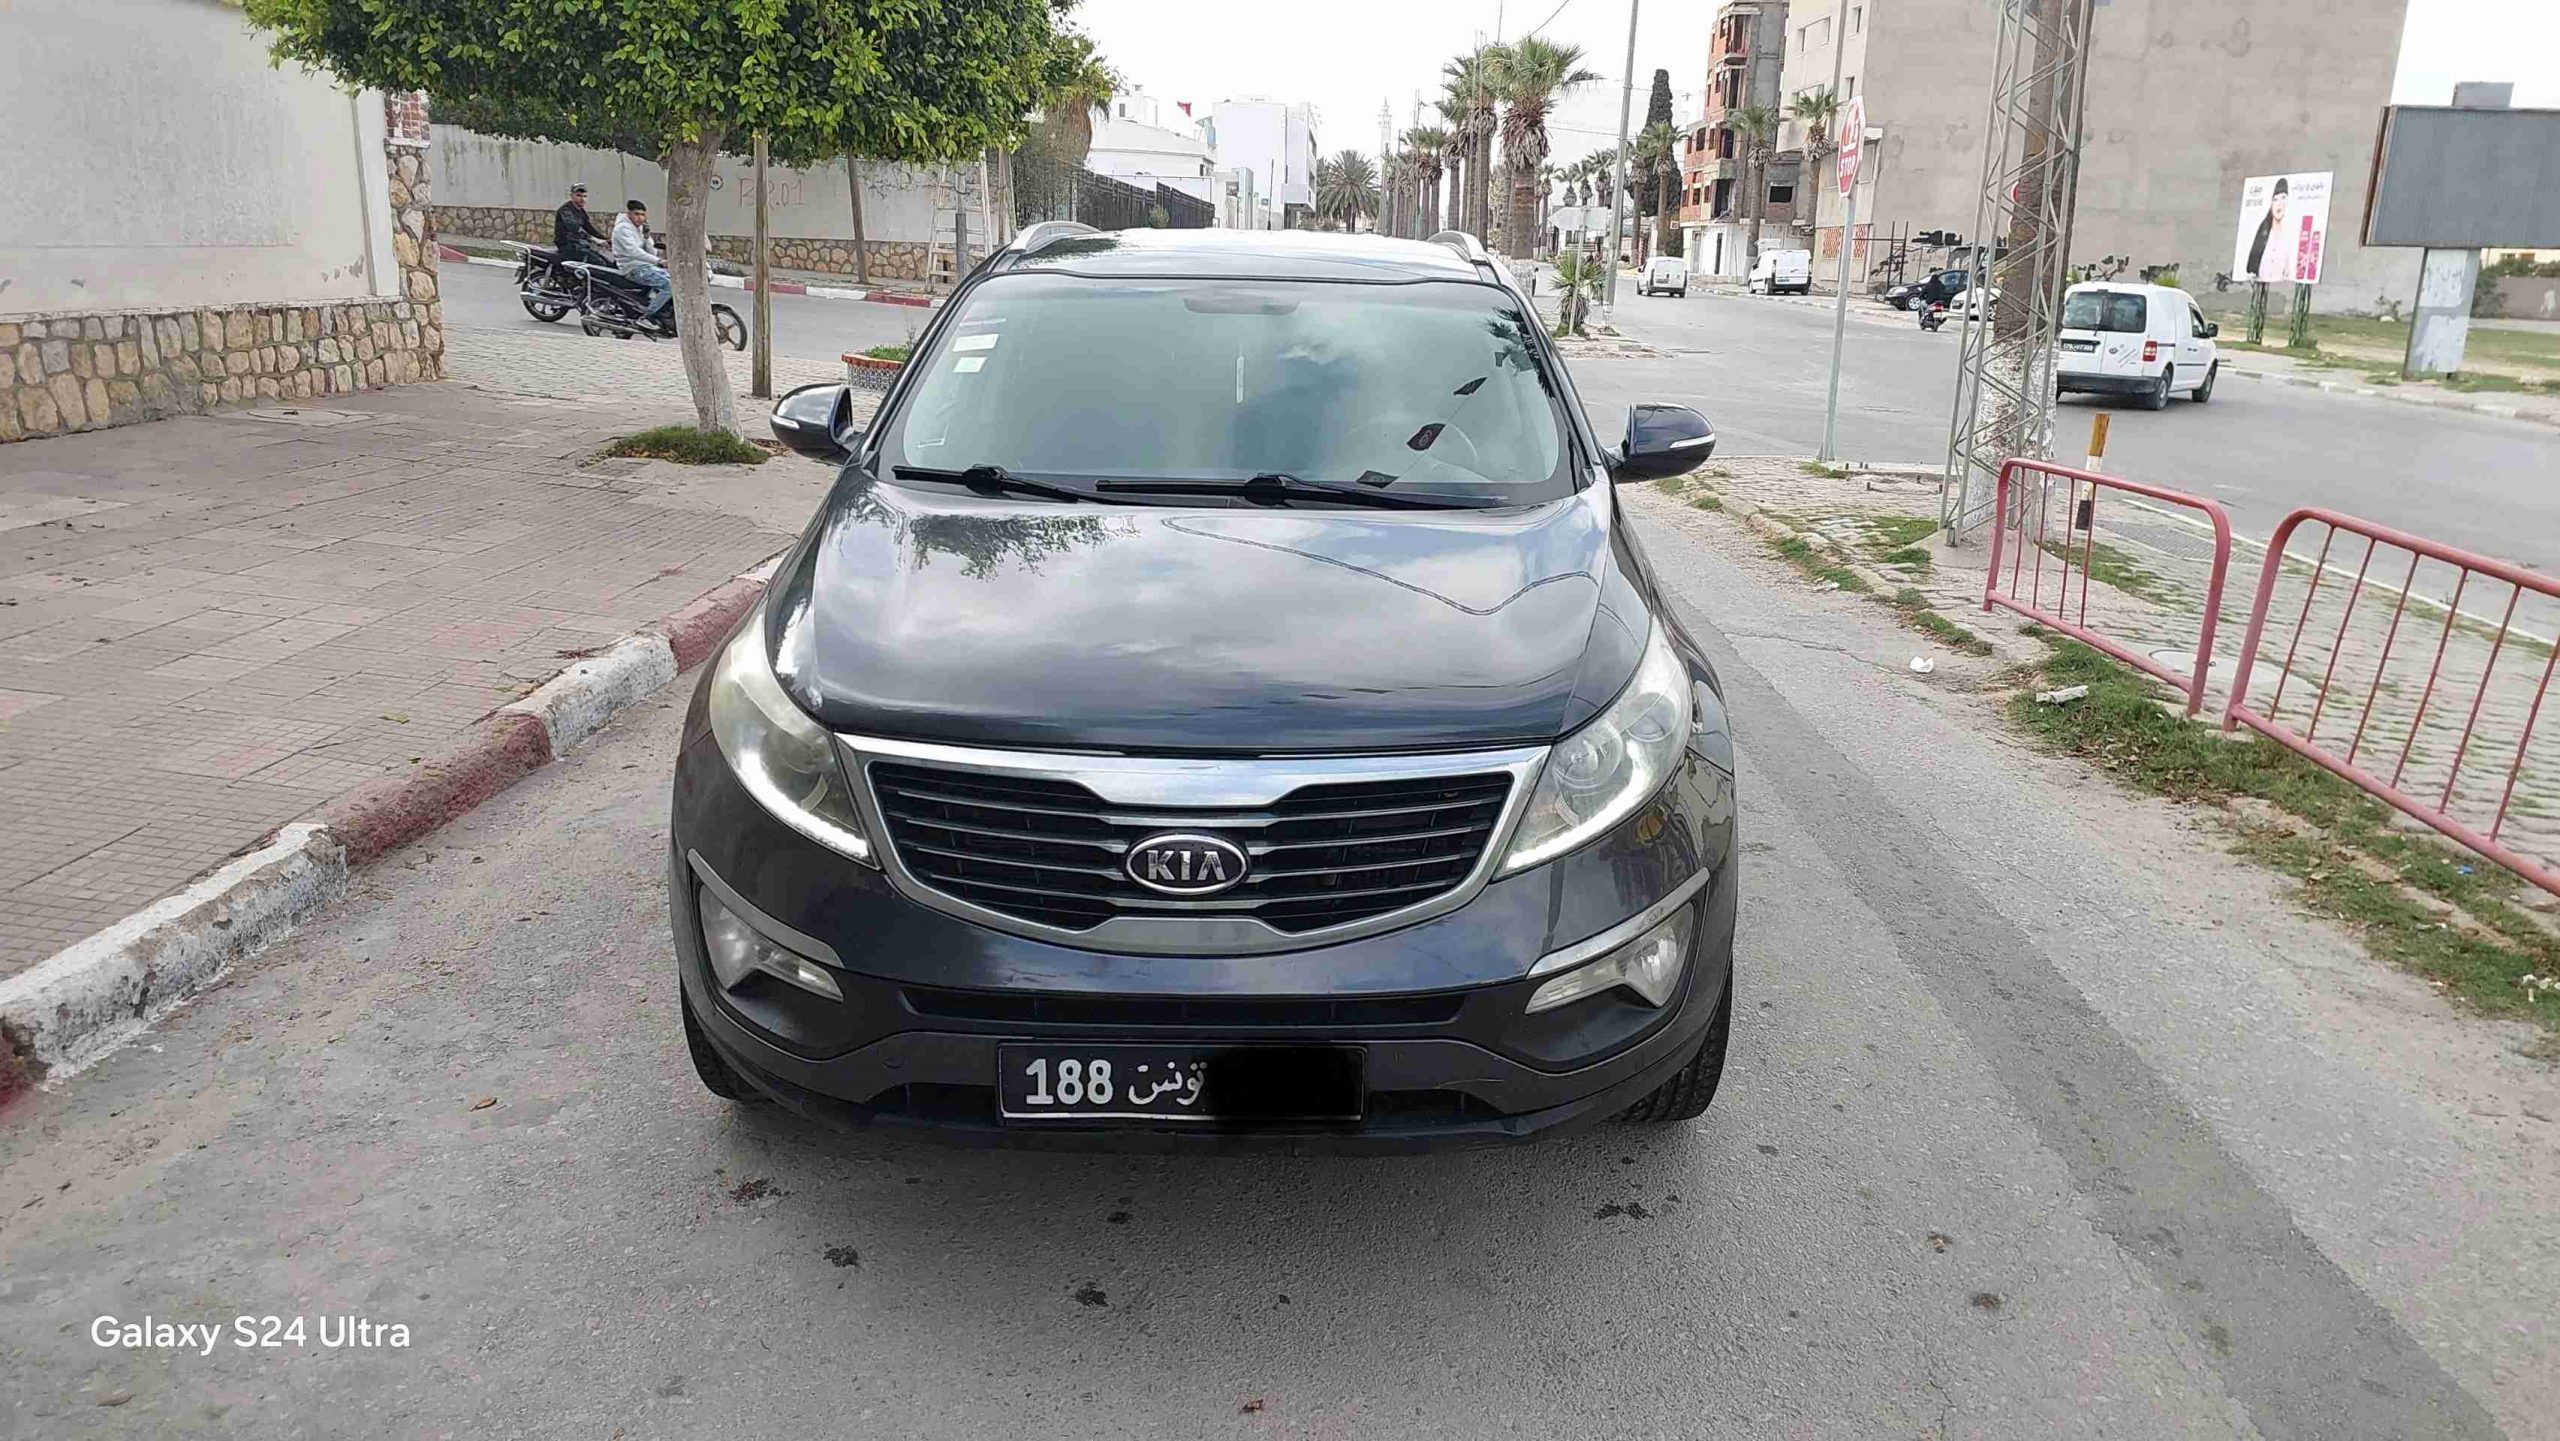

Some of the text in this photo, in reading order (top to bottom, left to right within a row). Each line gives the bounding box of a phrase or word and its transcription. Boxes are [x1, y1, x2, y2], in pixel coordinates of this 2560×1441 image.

[1839, 155, 1856, 177] STOP
[1146, 850, 1227, 880] KIA
[1026, 1058, 1114, 1105] 188
